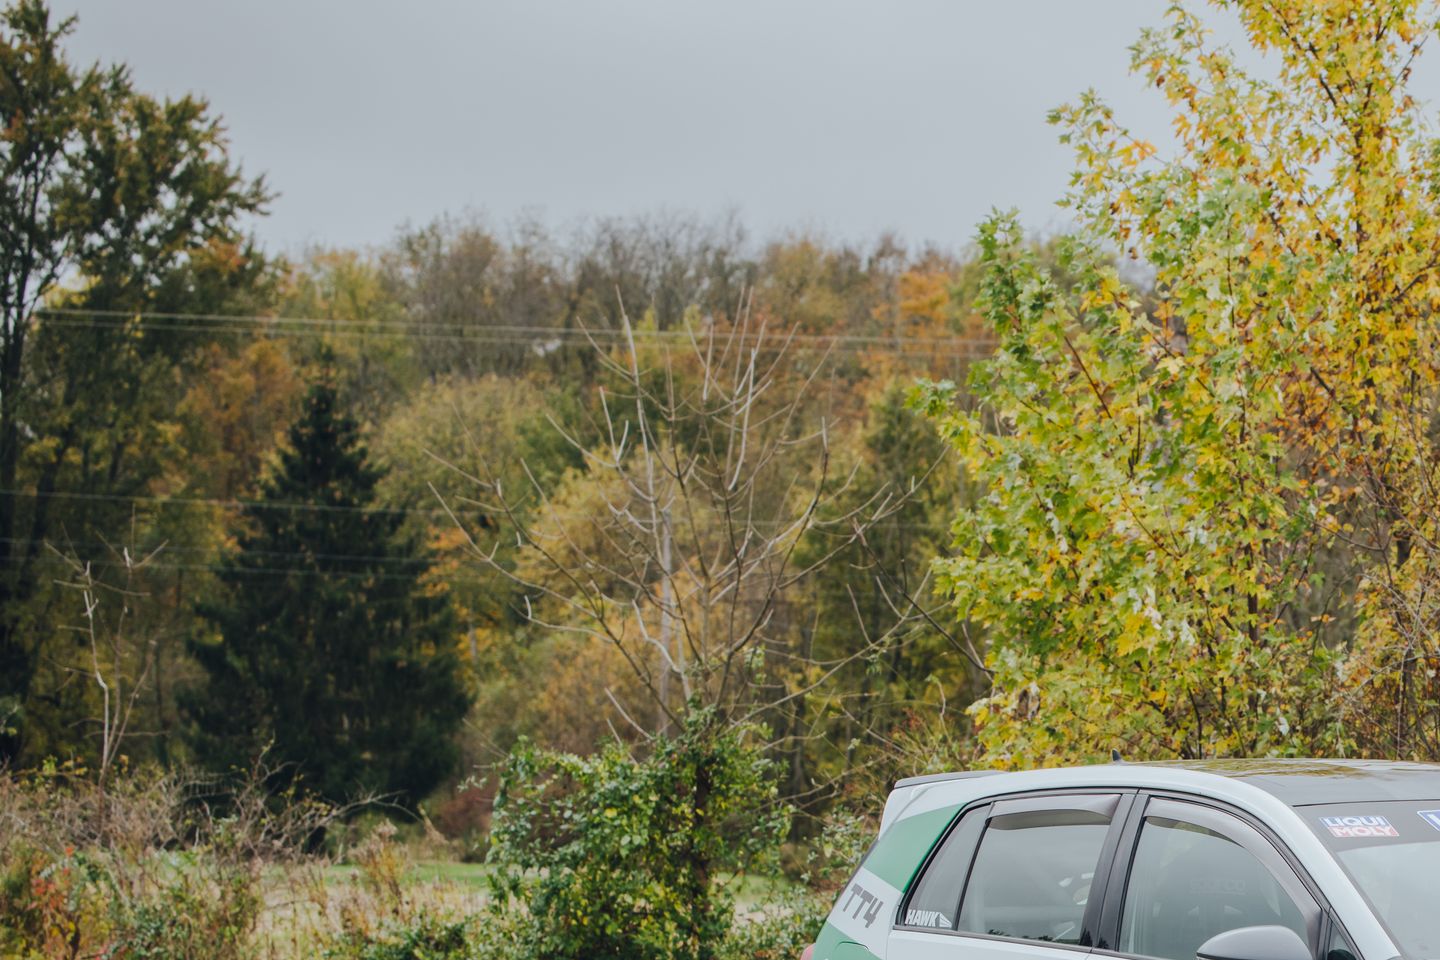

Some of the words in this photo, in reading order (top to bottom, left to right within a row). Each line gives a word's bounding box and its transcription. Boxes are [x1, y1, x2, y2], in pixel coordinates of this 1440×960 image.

[1322, 816, 1388, 827] LIQUI
[1330, 826, 1396, 836] MOLY
[843, 883, 884, 929] TT4
[905, 909, 939, 927] HAWK
